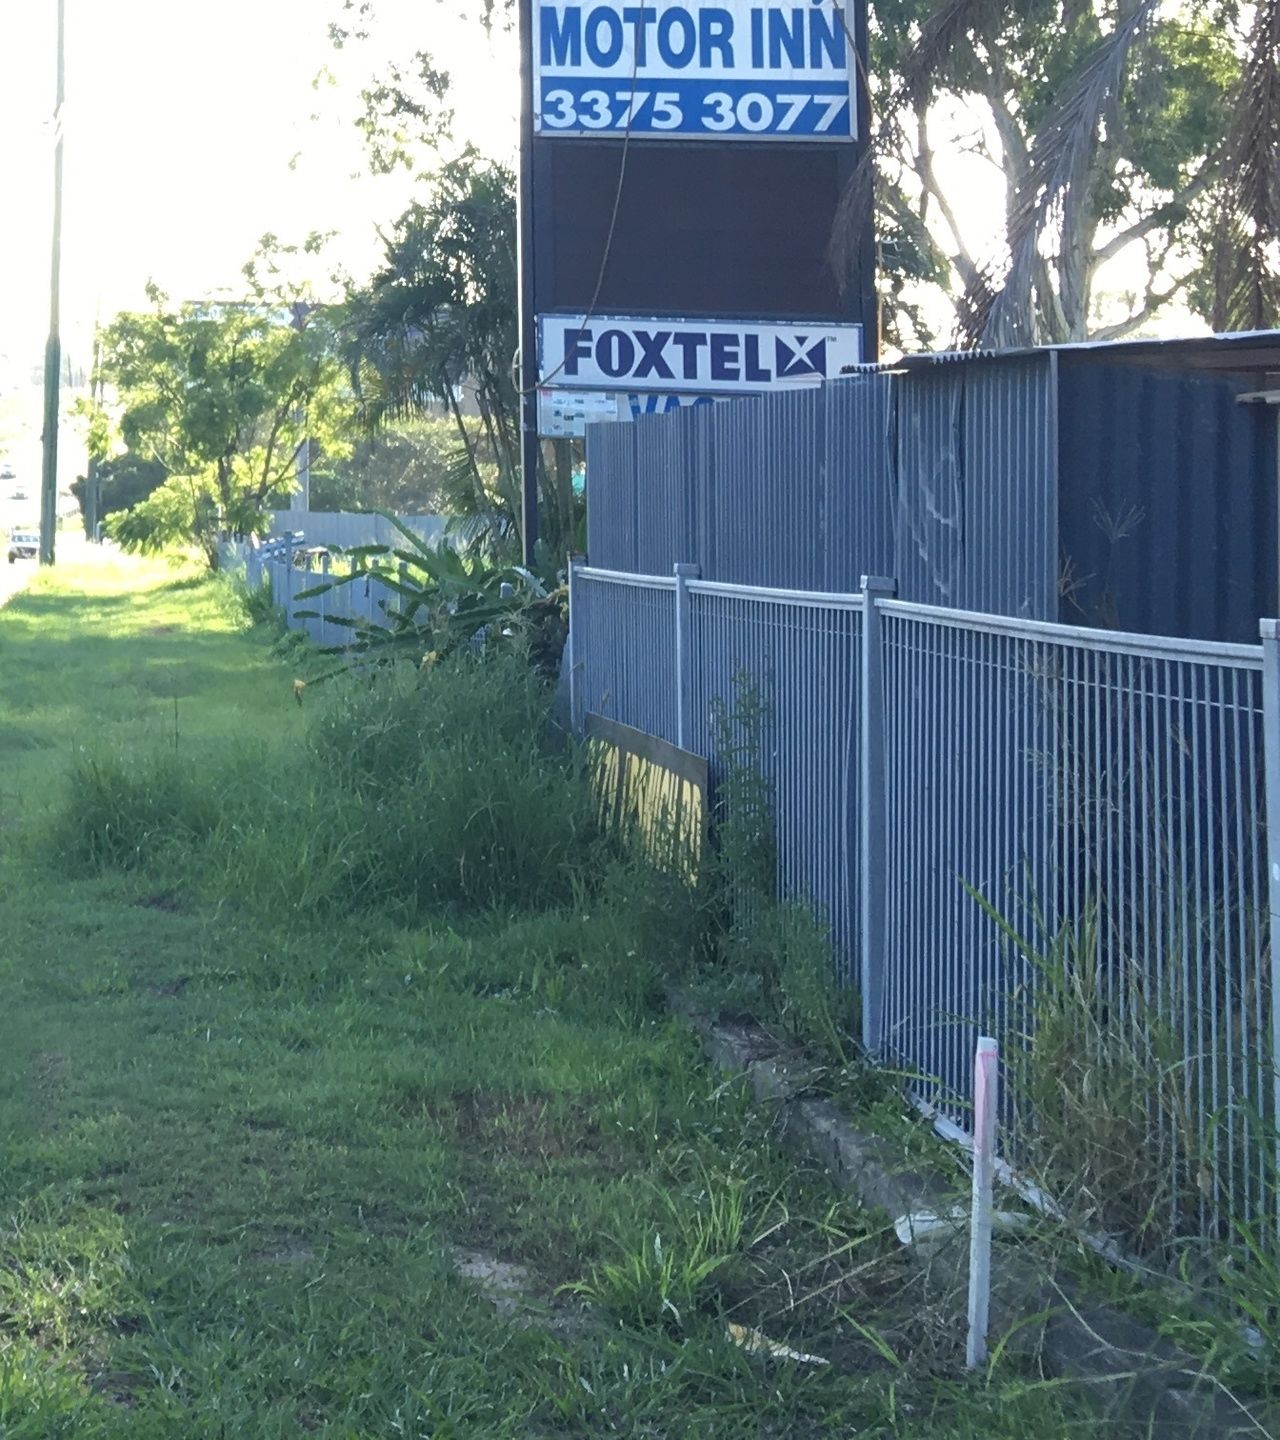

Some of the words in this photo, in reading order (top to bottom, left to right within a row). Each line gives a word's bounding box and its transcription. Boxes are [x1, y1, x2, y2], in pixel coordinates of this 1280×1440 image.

[540, 5, 735, 69] MOTOR
[750, 7, 846, 70] INN
[543, 89, 684, 130] 3375
[700, 92, 850, 132] 3077
[563, 328, 772, 382] FOXTEL
